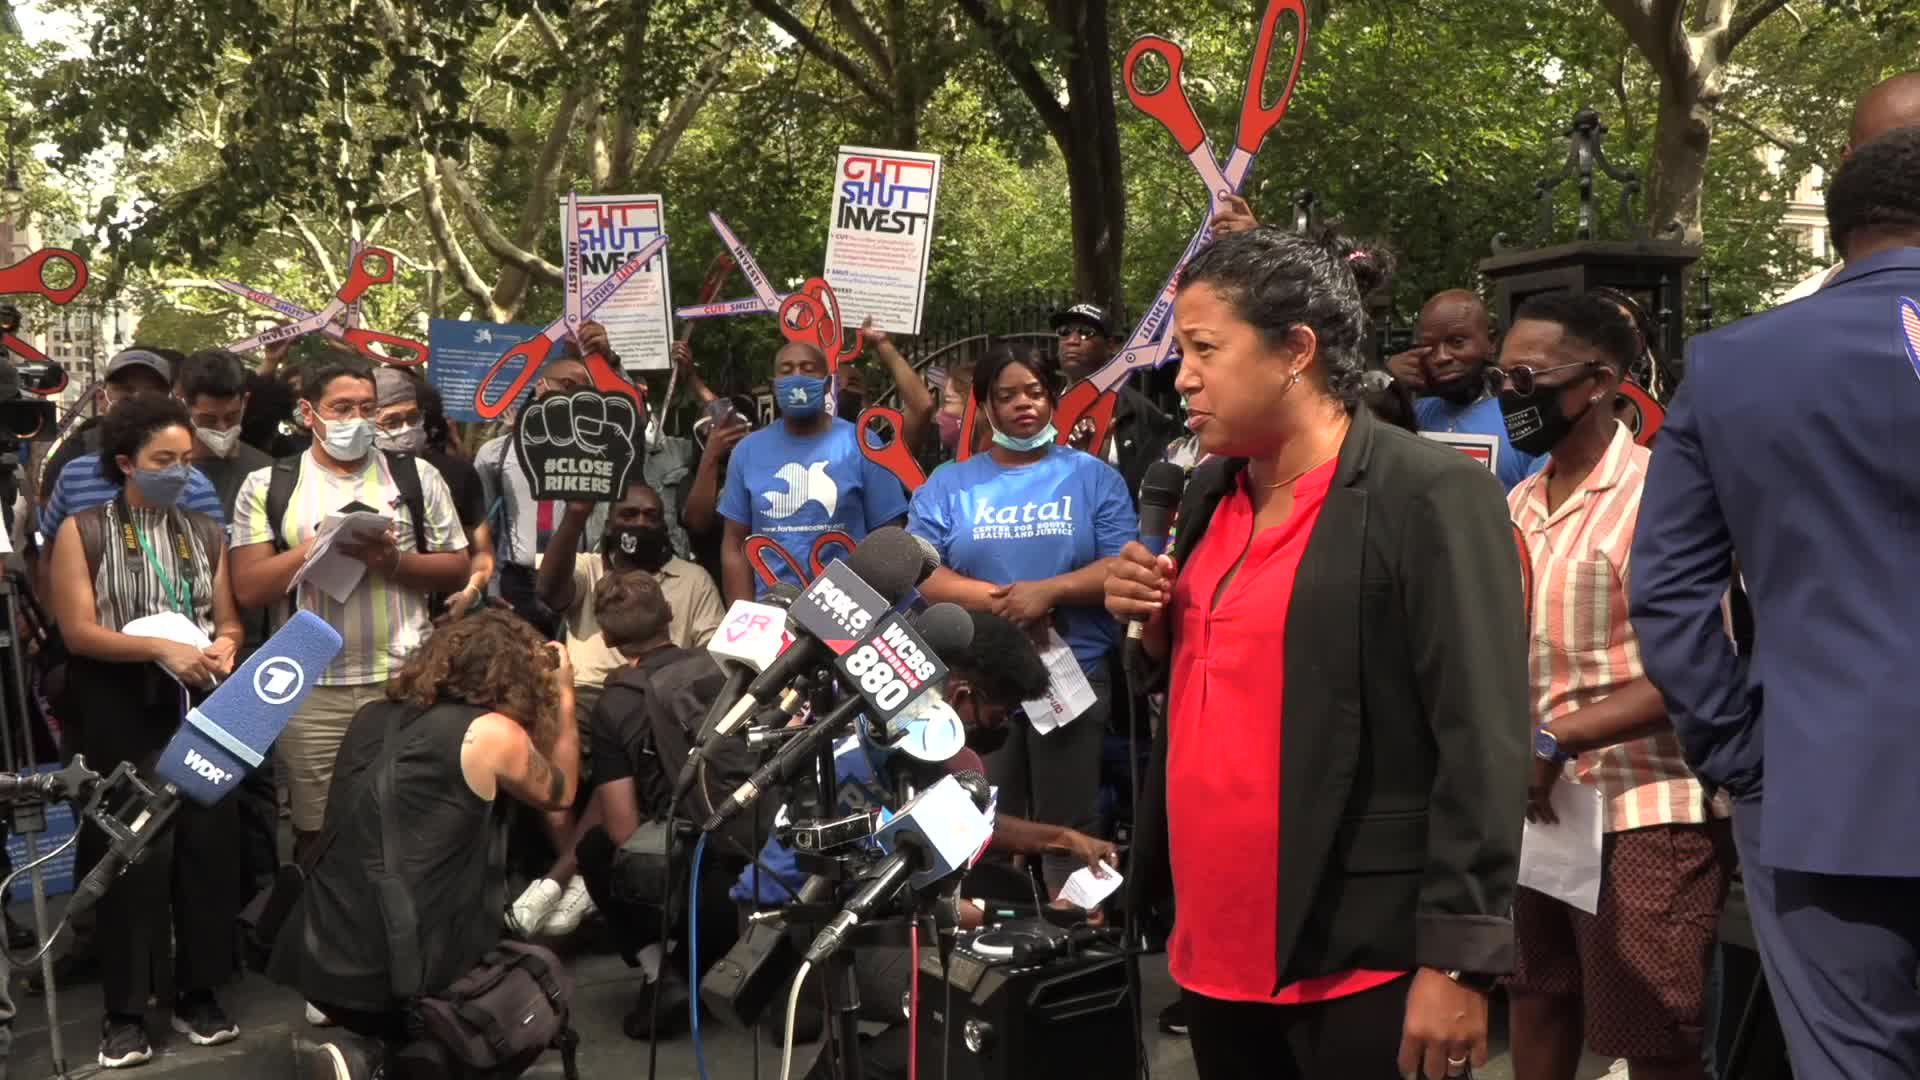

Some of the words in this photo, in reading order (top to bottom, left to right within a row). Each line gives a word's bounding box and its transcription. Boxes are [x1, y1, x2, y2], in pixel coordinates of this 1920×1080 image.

[843, 156, 934, 185] CUT
[842, 173, 929, 209] SHUT
[837, 196, 929, 235] INVEST
[568, 241, 578, 294] INVEST!
[734, 246, 763, 287] INVEST!
[585, 280, 616, 308] SHUT!
[703, 303, 726, 314] CUT!
[730, 301, 758, 311] SHUT!
[258, 325, 301, 344] INVEST!
[1139, 299, 1168, 340] SHUT!
[544, 457, 614, 477] #CLOSE
[544, 475, 611, 494] RIKERS
[973, 496, 1072, 525] katal
[973, 526, 1009, 534] CENTER
[1036, 528, 1073, 537] JUSTICE
[807, 593, 830, 612] NEW
[831, 611, 859, 638] YORK
[812, 577, 857, 618] FOX
[871, 635, 921, 690] NEWSRADIO
[882, 622, 936, 682] WCBS
[845, 644, 909, 712] 880
[183, 749, 225, 785] WDR
